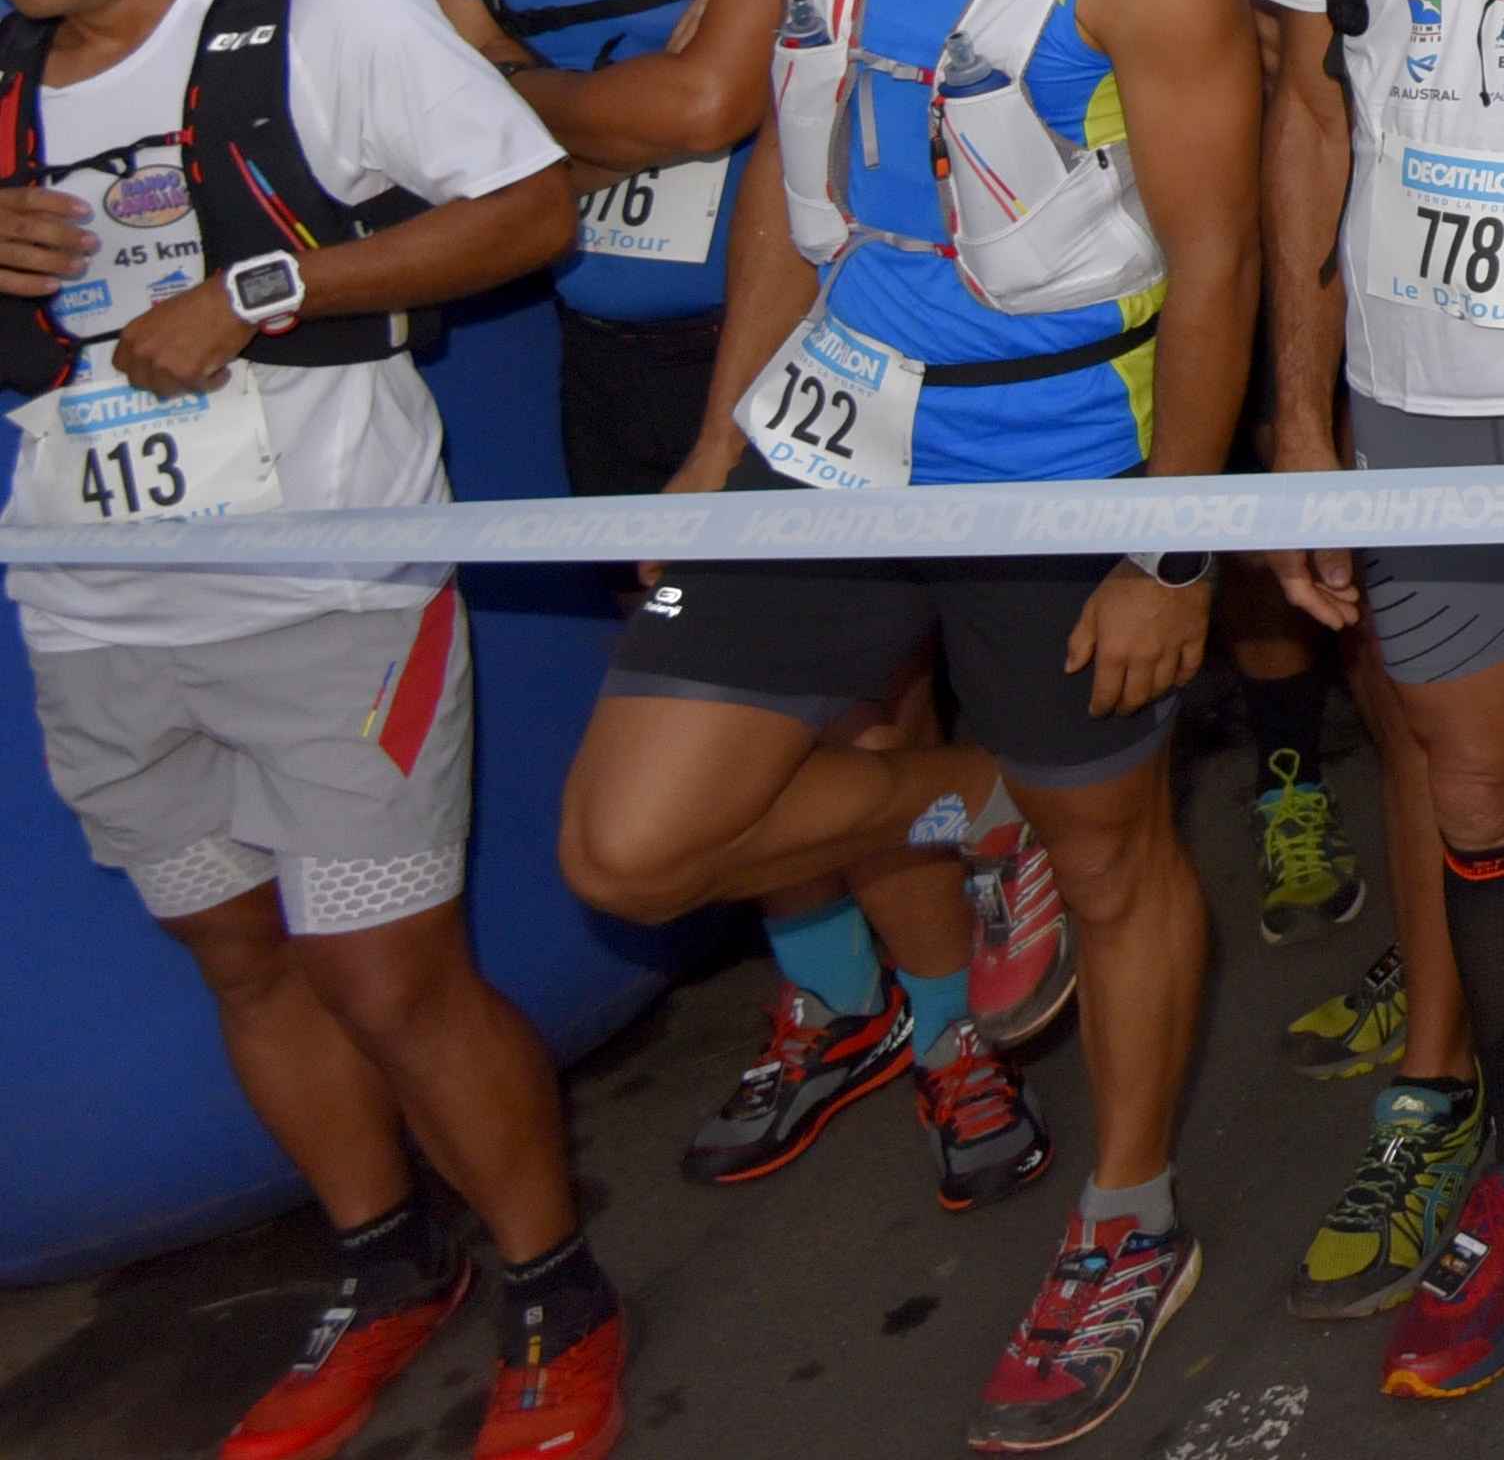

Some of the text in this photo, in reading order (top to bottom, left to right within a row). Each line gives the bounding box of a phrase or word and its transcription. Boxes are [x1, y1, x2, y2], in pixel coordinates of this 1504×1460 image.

[114, 243, 148, 268] 45
[1393, 276, 1419, 300] Le
[82, 431, 187, 517] 413
